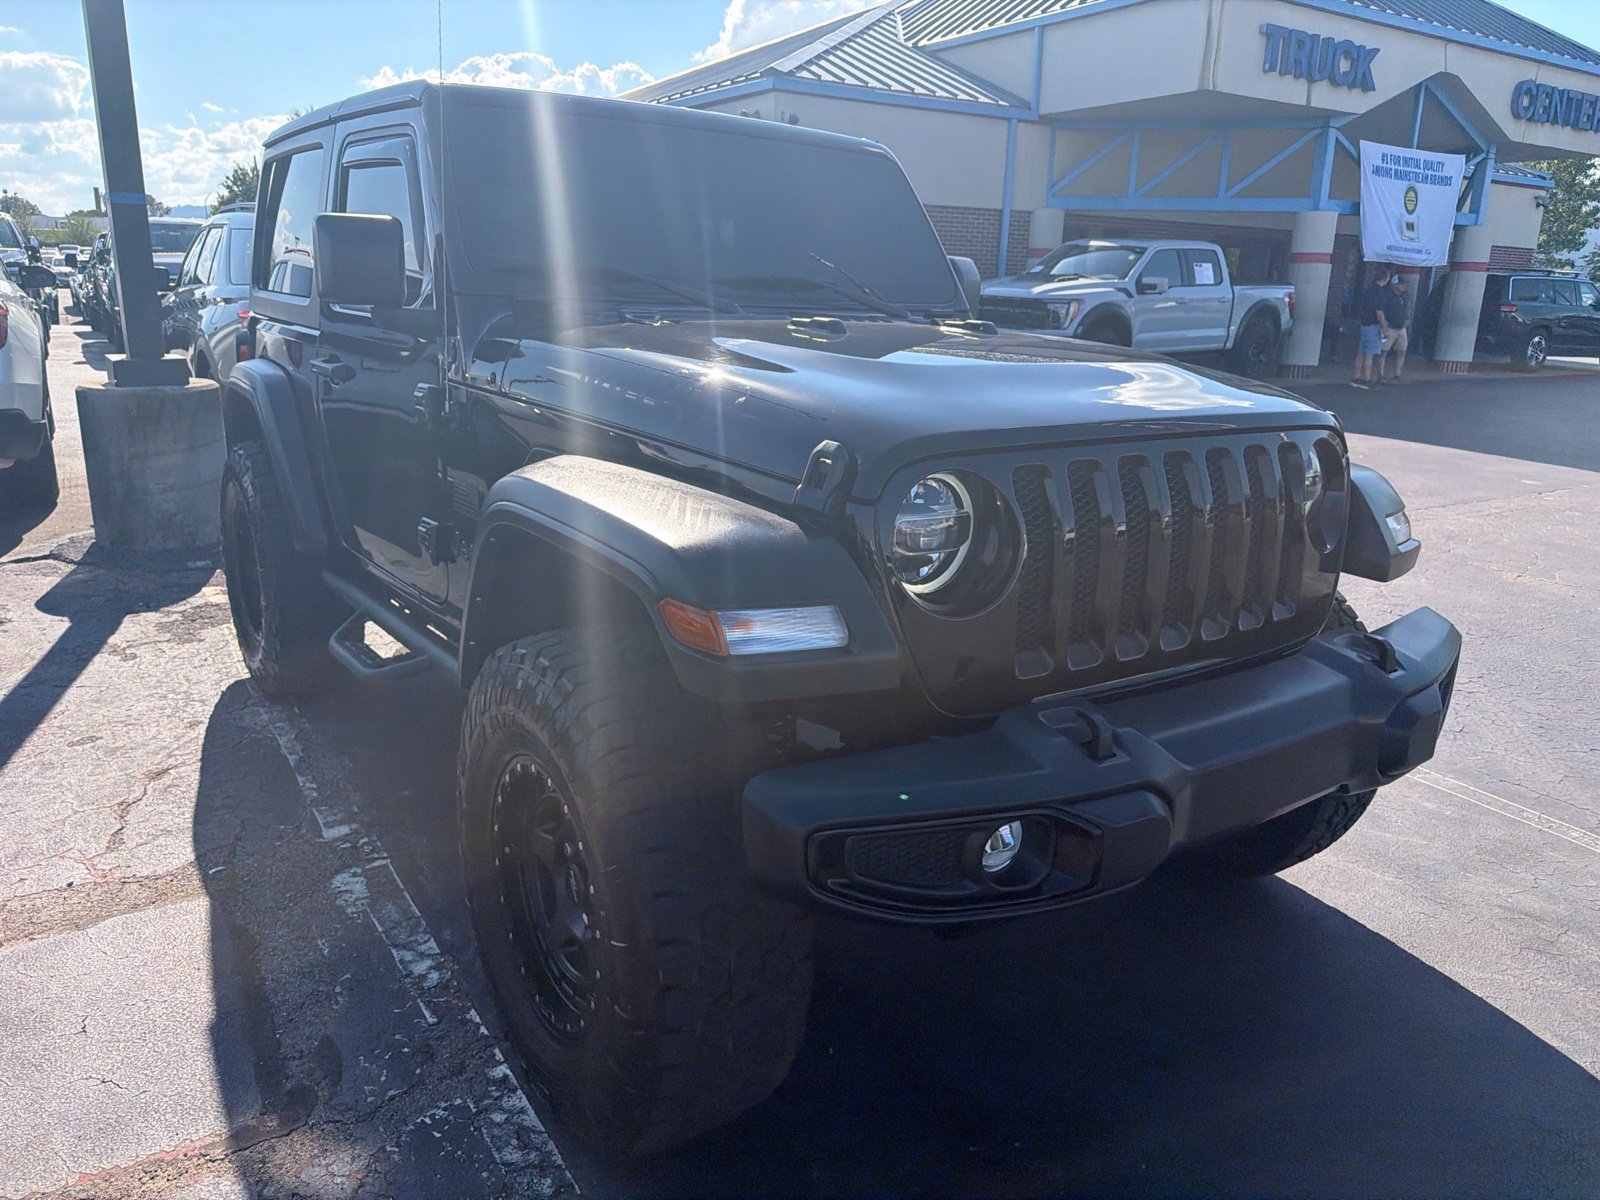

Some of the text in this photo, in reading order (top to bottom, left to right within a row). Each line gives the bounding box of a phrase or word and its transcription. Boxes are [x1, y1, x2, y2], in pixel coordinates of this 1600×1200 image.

[1260, 23, 1381, 92] TRUCK
[1381, 152, 1445, 173] #1 FOR INITIAL QUALITY
[1372, 164, 1453, 187] AMONG MAINSTREAM BRANDS
